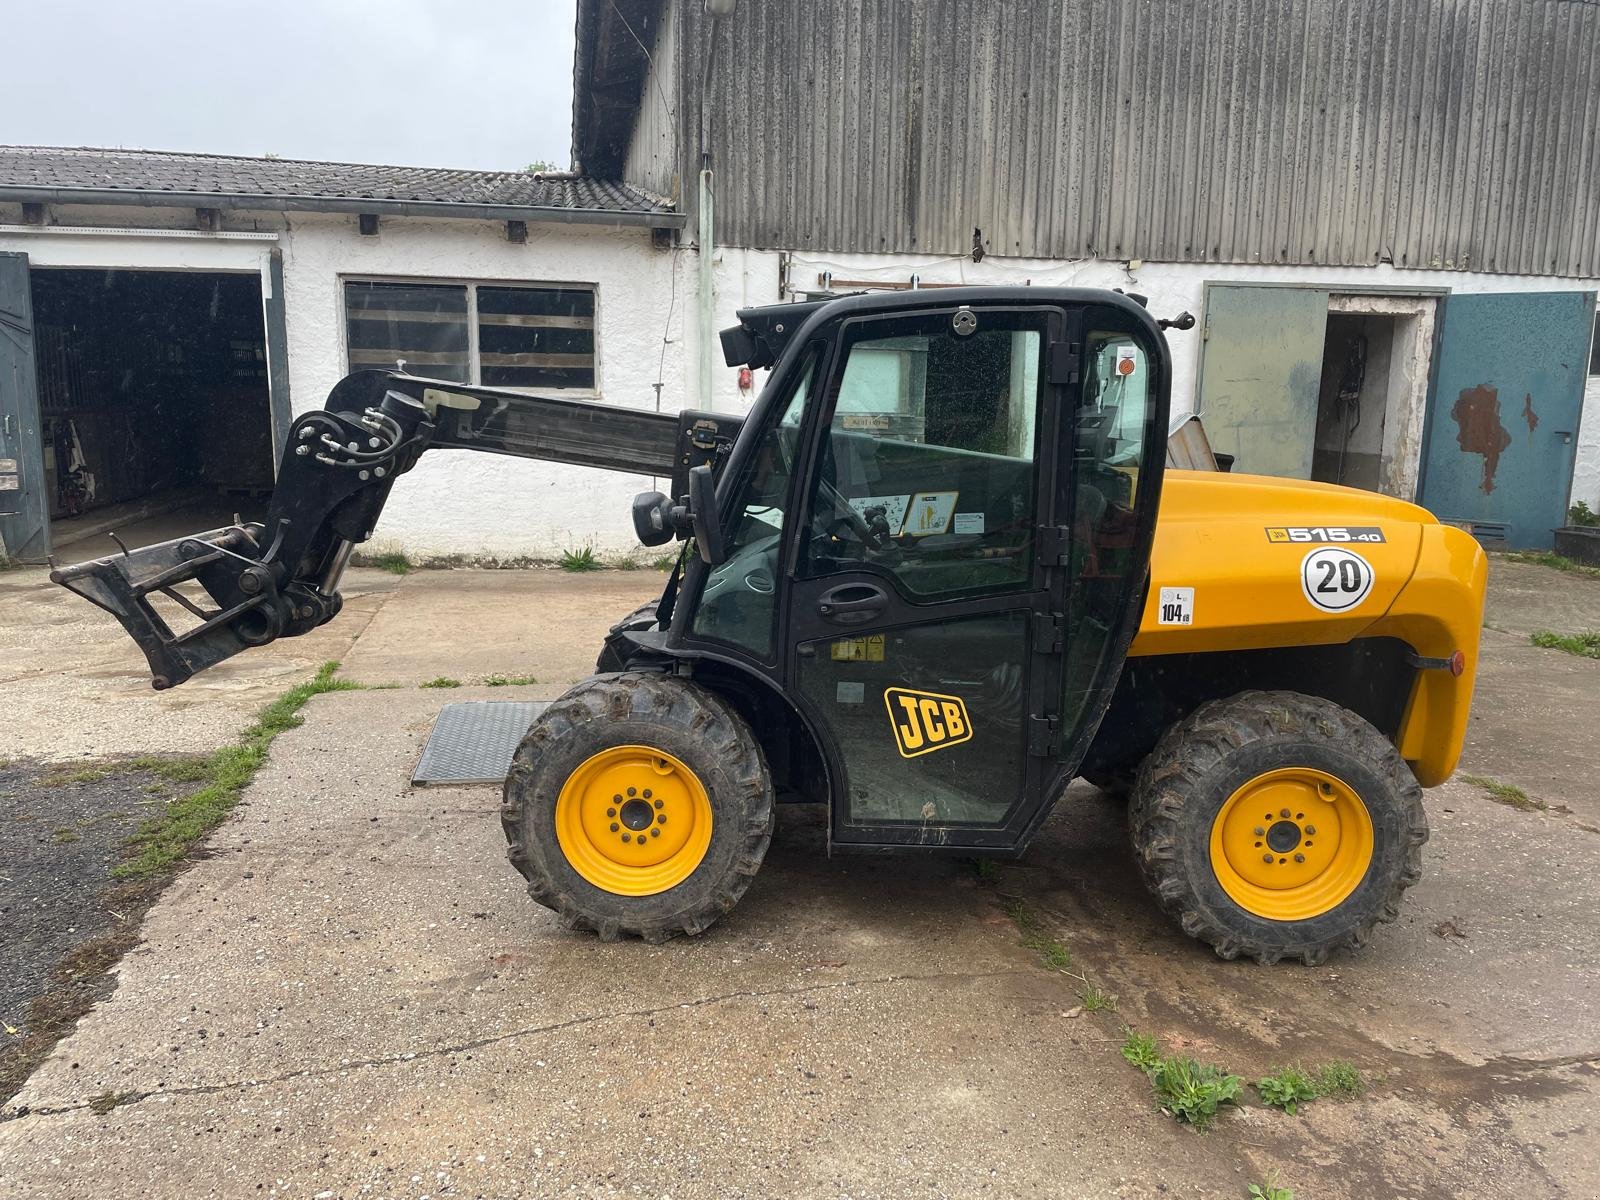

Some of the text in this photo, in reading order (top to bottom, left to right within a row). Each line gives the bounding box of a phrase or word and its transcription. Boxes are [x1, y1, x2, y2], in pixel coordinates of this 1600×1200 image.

[1316, 560, 1361, 592] 20
[1162, 604, 1182, 621] 104
[899, 695, 964, 749] JCB
